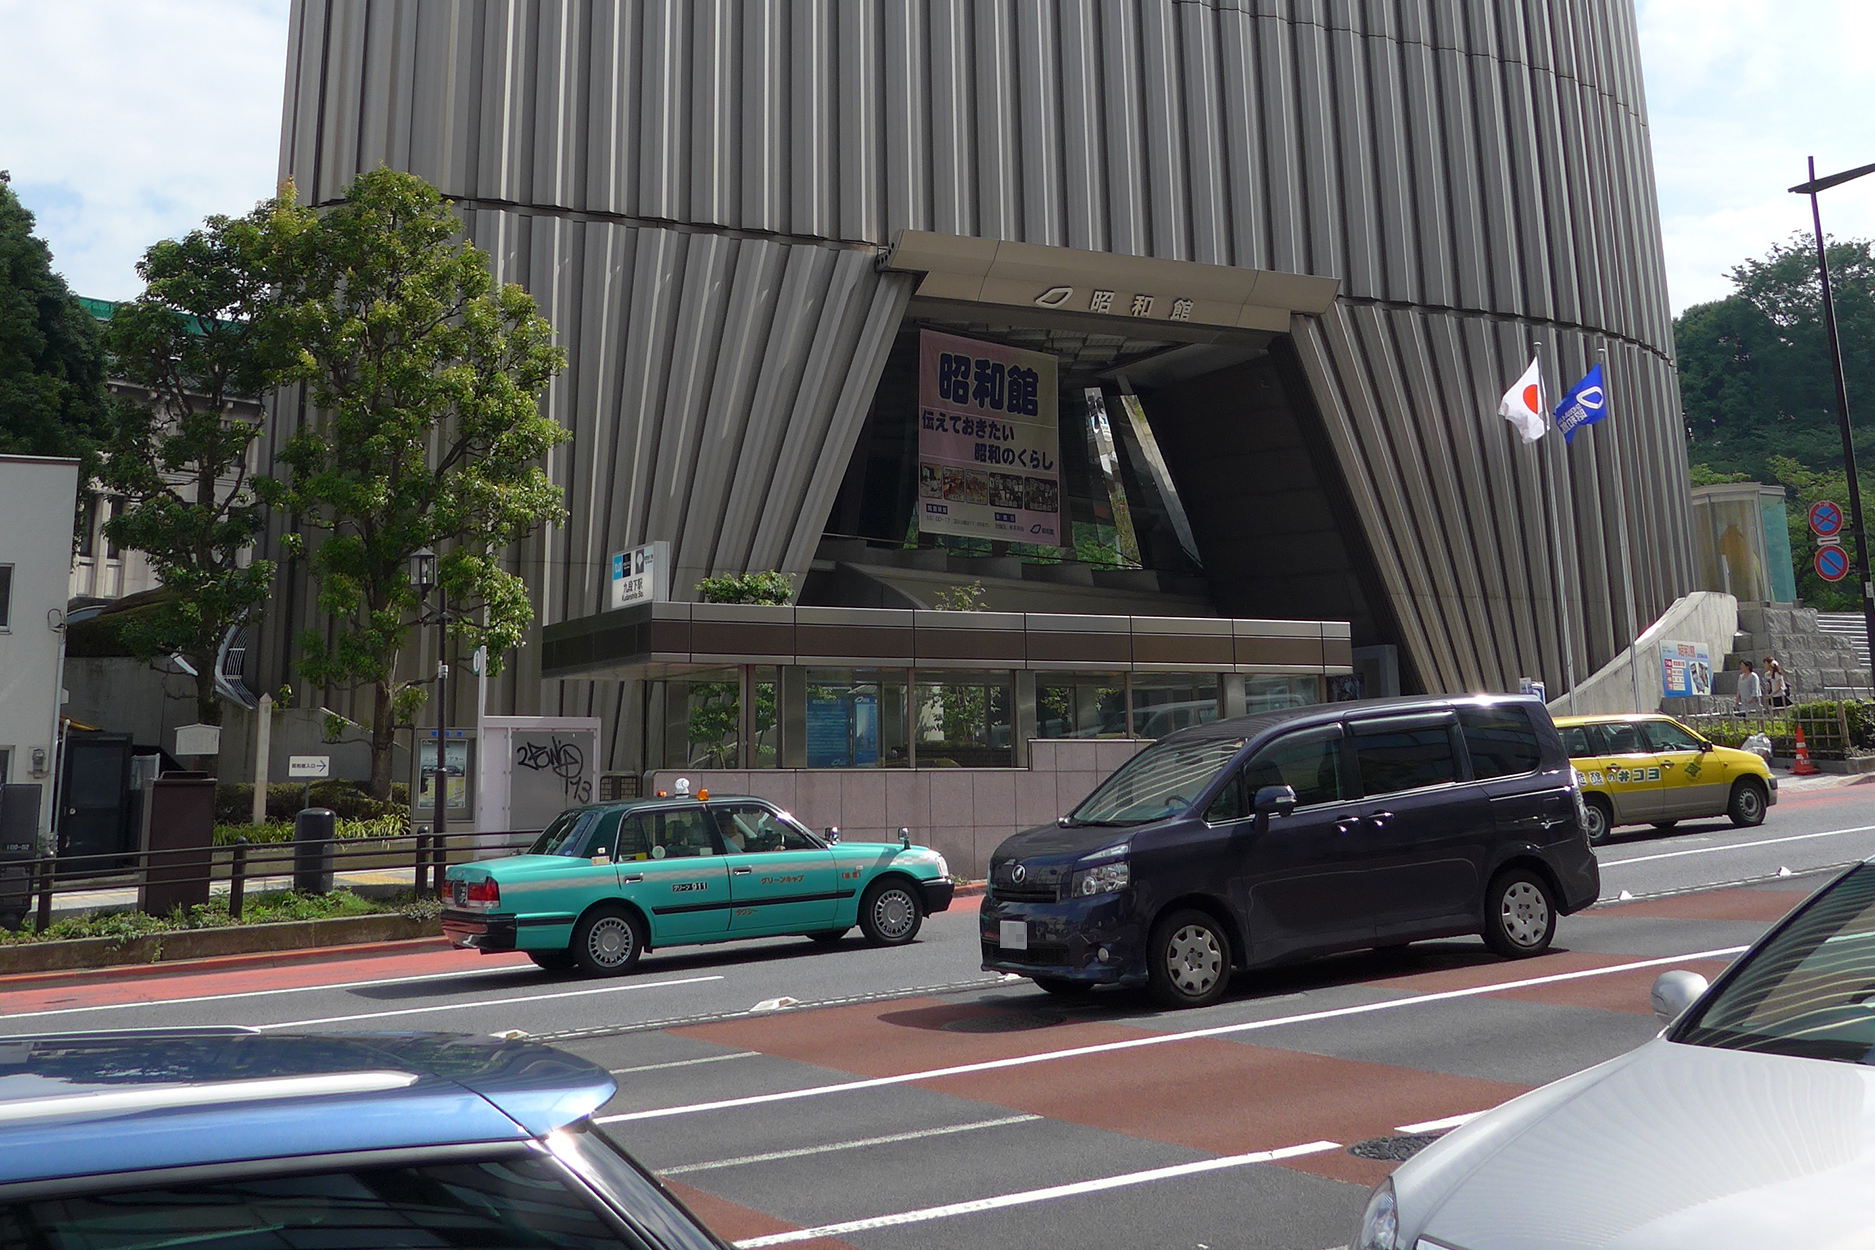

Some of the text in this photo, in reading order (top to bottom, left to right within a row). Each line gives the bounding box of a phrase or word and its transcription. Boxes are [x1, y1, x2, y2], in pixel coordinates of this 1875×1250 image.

[1089, 289, 1194, 323] 昭和館
[939, 352, 1039, 417] 昭和館
[921, 409, 1015, 442] 伝えておきたい
[974, 442, 1054, 471] 昭和のくらし
[691, 881, 706, 891] 911
